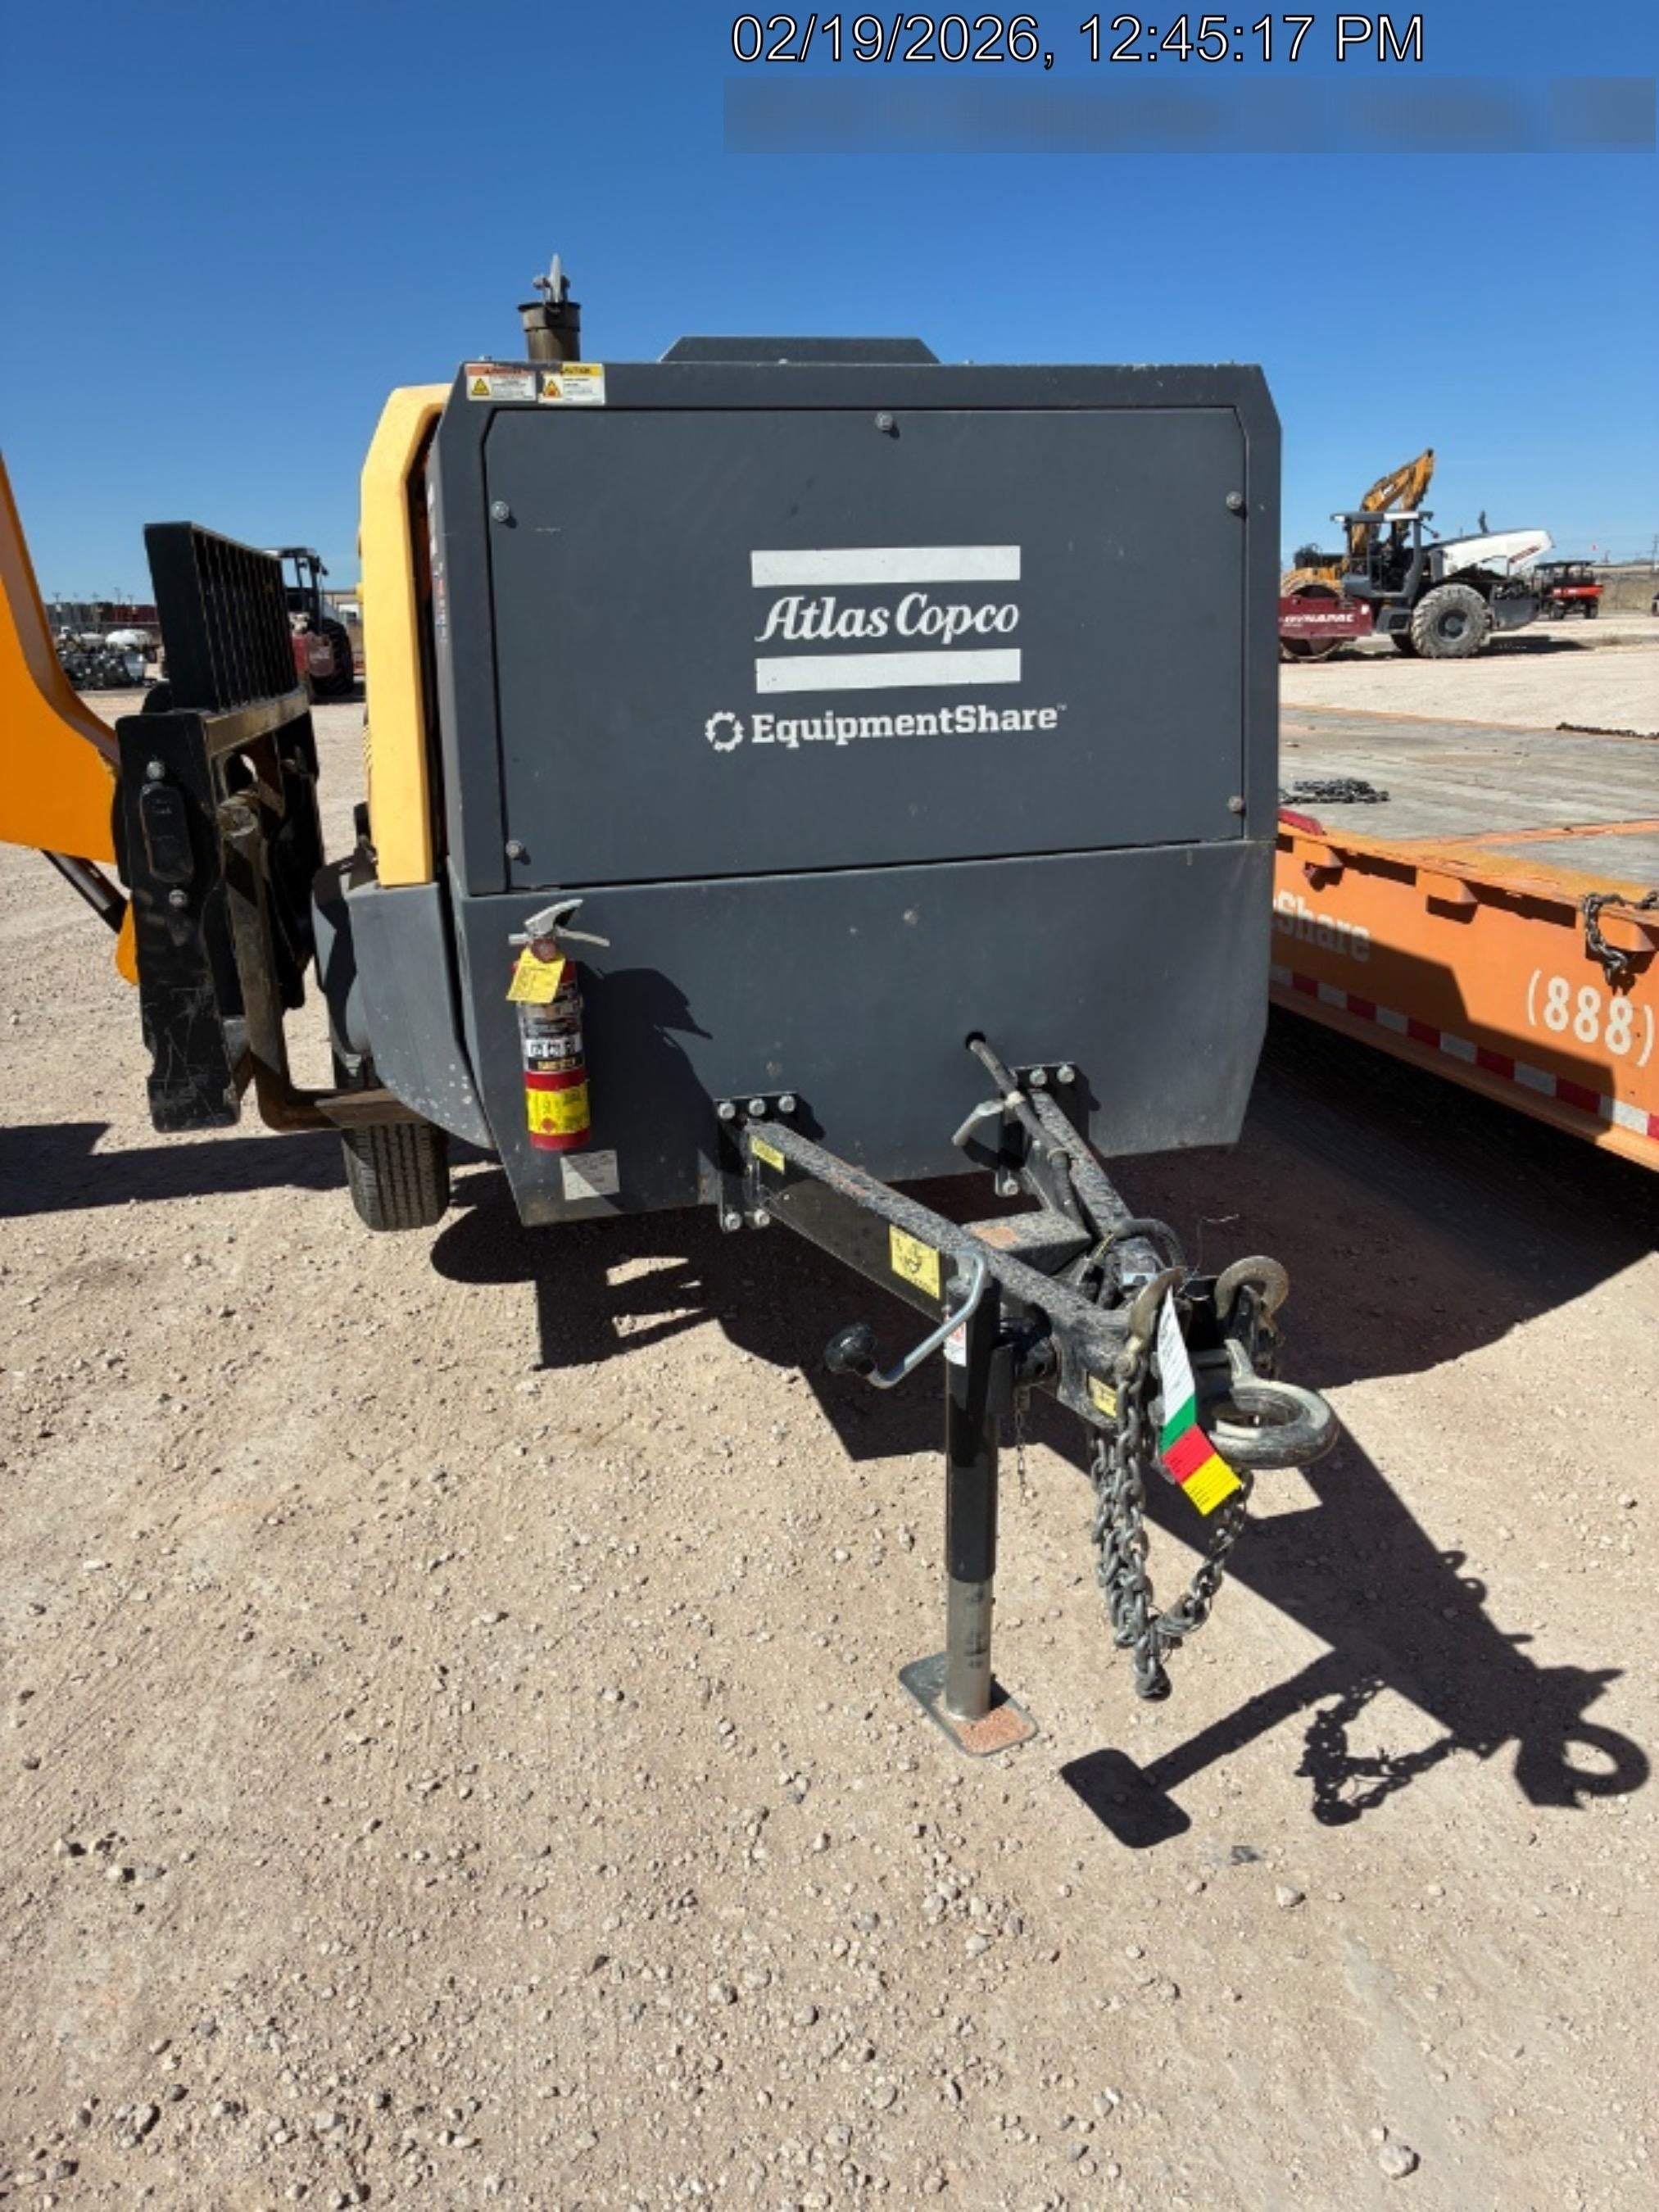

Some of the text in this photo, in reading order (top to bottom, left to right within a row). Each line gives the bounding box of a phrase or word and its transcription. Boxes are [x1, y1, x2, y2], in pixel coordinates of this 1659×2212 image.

[755, 592, 1020, 645] Atlas Copco
[1272, 888, 1371, 963] Share
[1526, 968, 1655, 1067] (888)
